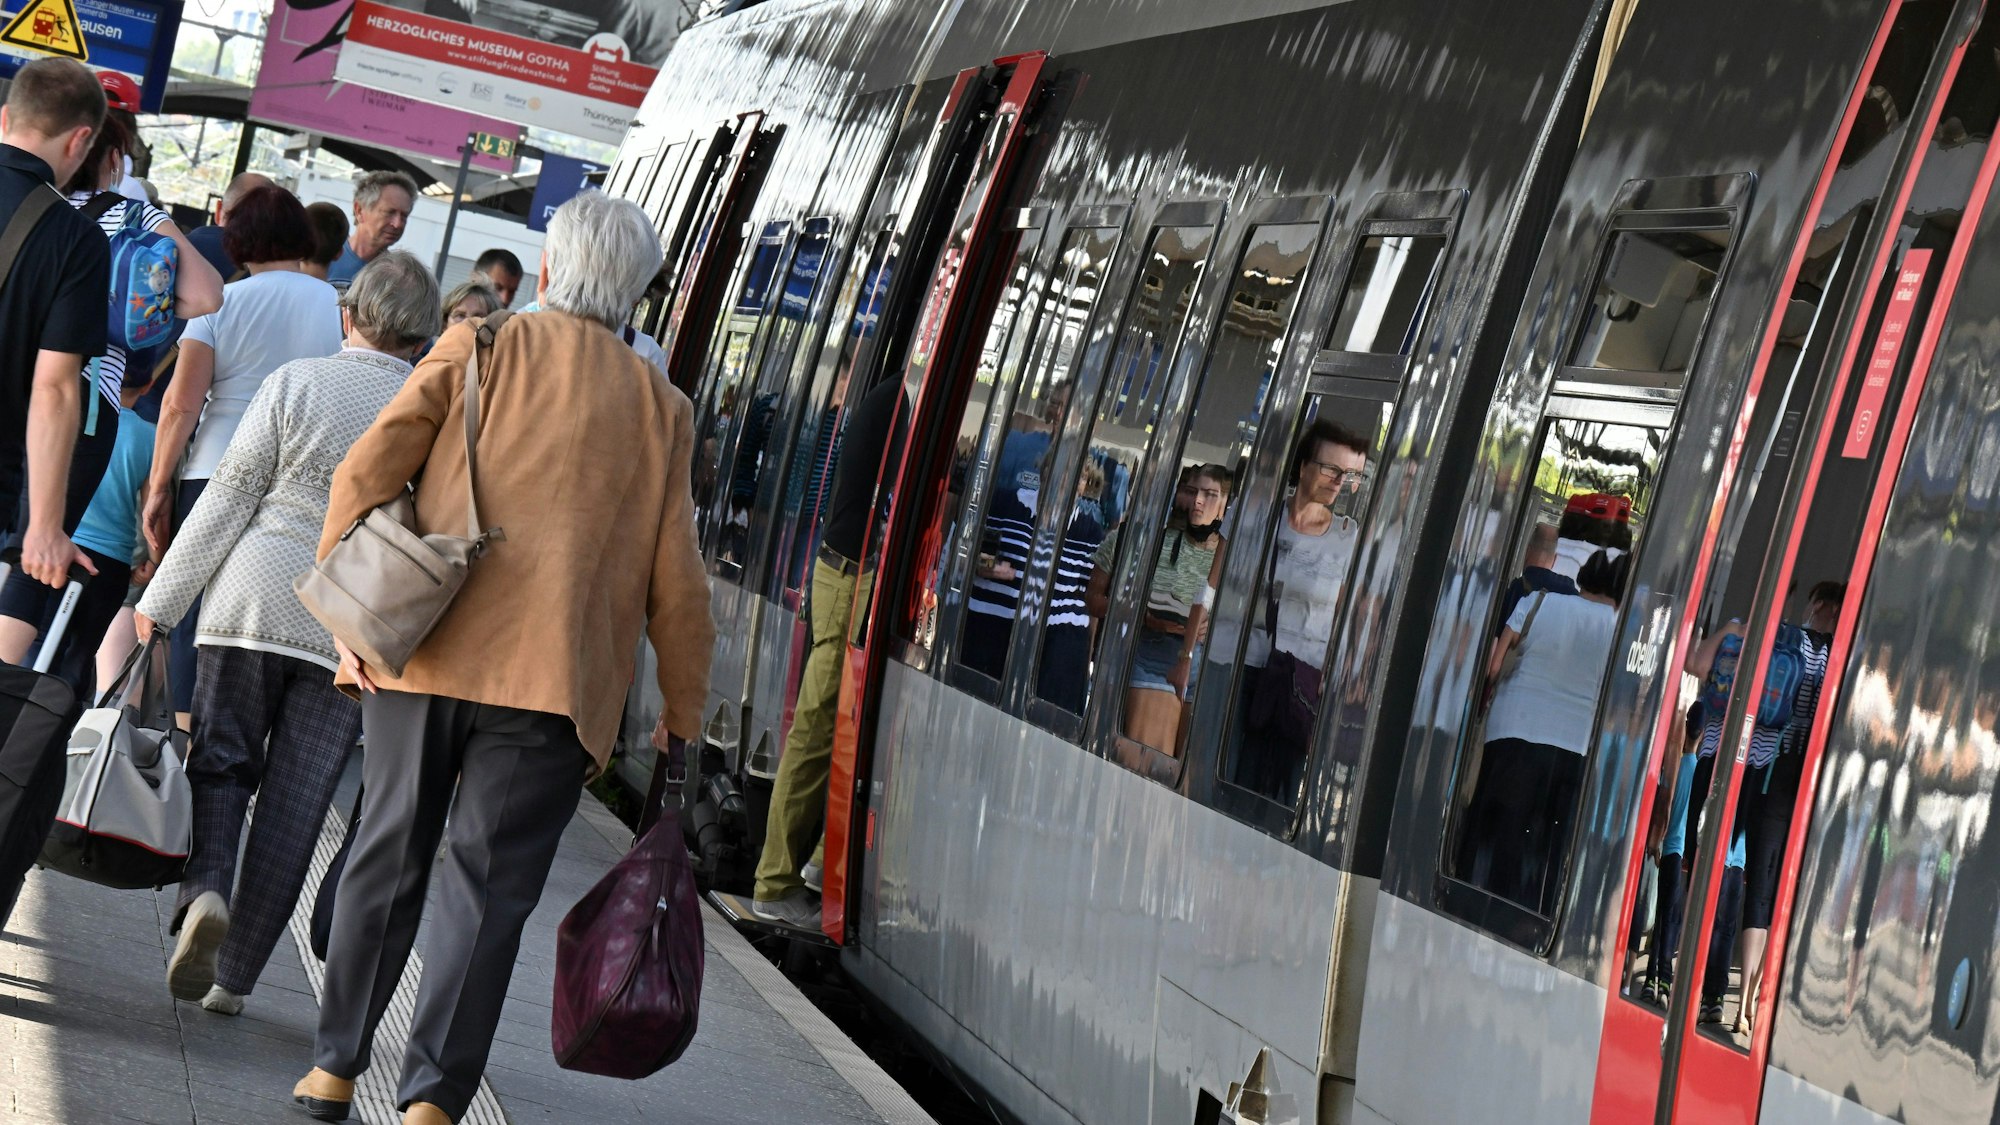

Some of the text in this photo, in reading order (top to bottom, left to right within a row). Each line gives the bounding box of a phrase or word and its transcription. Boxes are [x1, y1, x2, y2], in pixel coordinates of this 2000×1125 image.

[366, 14, 570, 72] HERZOGLICHES MUSEUM GOTHA
[447, 50, 568, 84] www.stiftungfriedenstein.de
